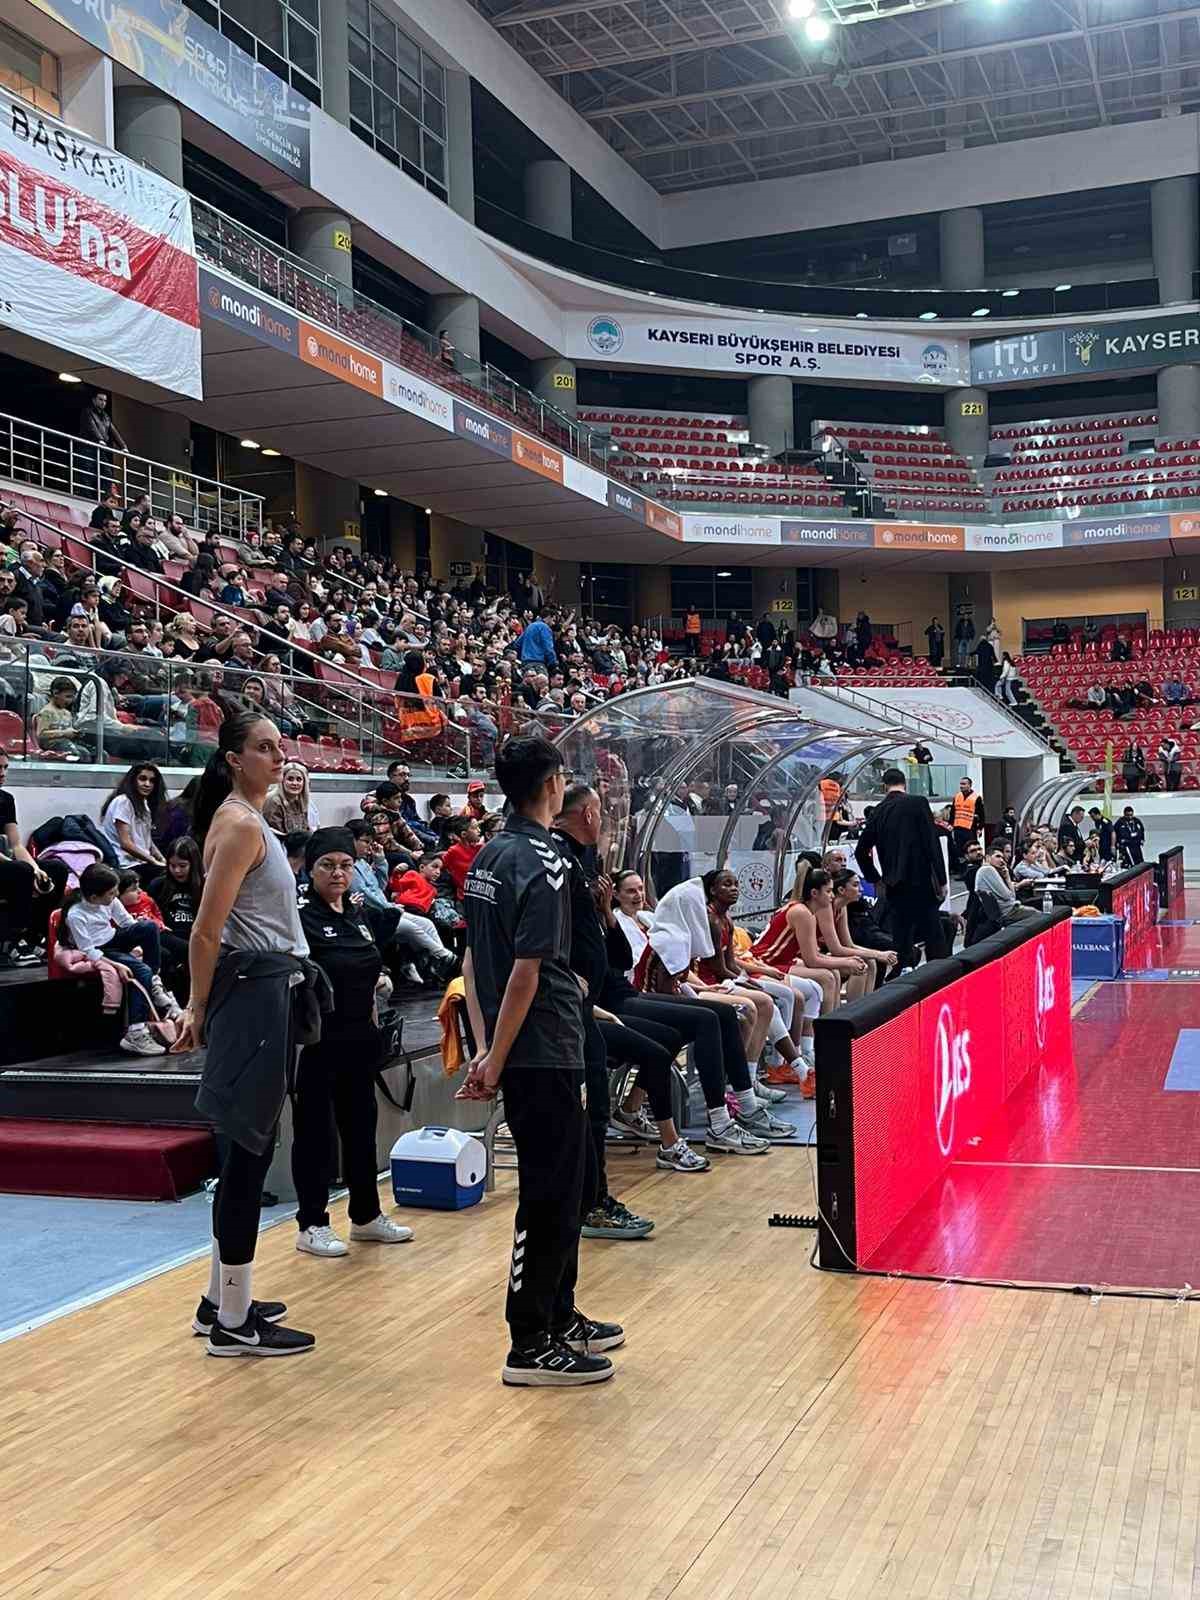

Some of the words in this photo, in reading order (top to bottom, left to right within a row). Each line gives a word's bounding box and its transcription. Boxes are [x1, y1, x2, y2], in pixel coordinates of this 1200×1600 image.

[337, 233, 352, 249] 20
[221, 294, 292, 343] mondihome
[647, 328, 713, 346] KAYSERİ
[717, 333, 814, 354] BÜYÜKŞEHİR
[817, 342, 900, 358] BELEDİYESİ
[994, 335, 1038, 367] İTÜ
[317, 342, 377, 385] mondihome
[735, 352, 782, 367] SPOR
[789, 356, 821, 371] A.Ş.
[556, 375, 574, 388] 201
[978, 370, 1004, 380] ETA
[398, 382, 448, 418] mondihome
[964, 403, 982, 415] 221
[703, 523, 773, 538] mondihome
[800, 526, 867, 542] mondihome
[894, 530, 960, 544] mondihome
[983, 529, 1054, 546] mondihome
[1084, 520, 1161, 539] mondihome
[1175, 588, 1196, 600] 121
[775, 600, 793, 610] 122
